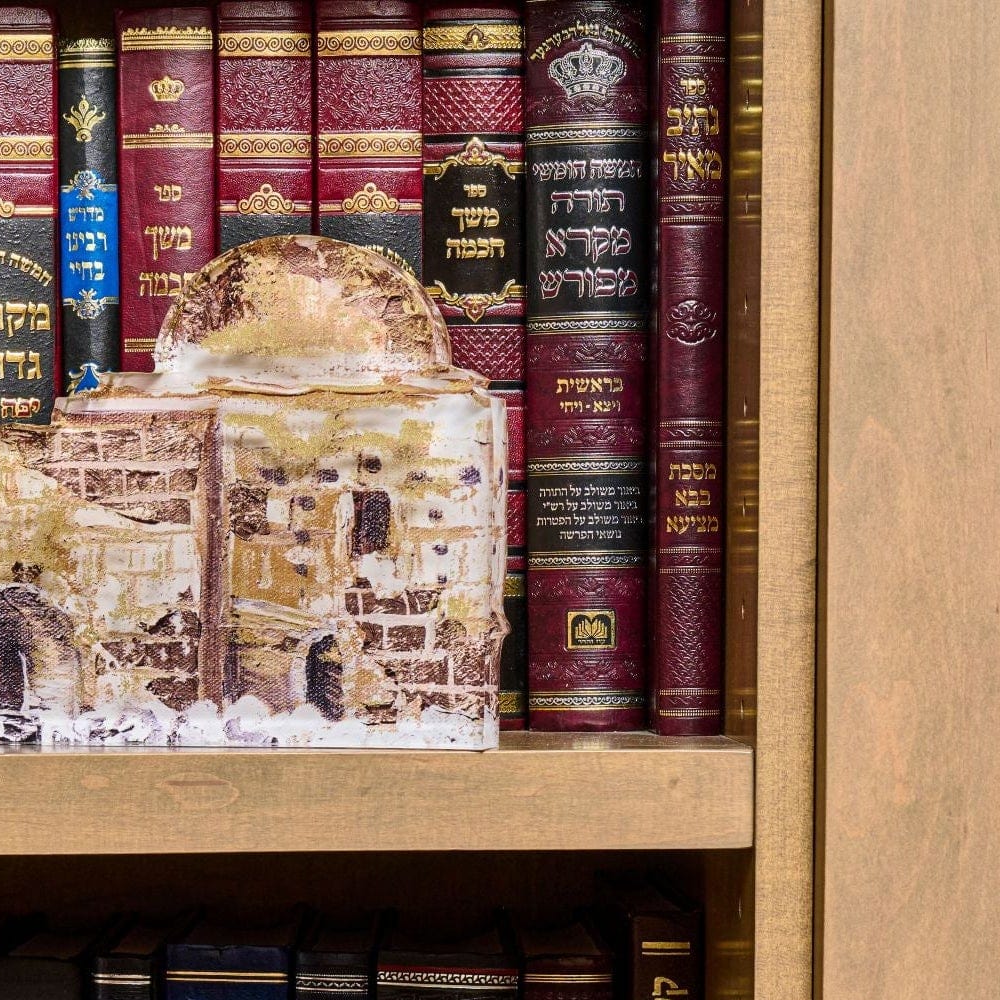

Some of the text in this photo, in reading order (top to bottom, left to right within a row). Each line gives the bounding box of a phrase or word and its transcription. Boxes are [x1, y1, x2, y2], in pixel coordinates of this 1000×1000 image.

[680, 78, 706, 95] ספר
[666, 104, 718, 136] נתיב
[532, 158, 642, 181] חמשה חומשי
[663, 149, 722, 181] מאיר
[154, 185, 182, 201] ספר
[463, 183, 487, 198] ספר
[551, 188, 625, 214] תורה
[68, 206, 104, 222] מדרש
[451, 206, 500, 232] משך
[66, 232, 107, 252] רבינו
[144, 225, 192, 260] משך
[446, 237, 505, 260] חכמה
[545, 225, 631, 264] מקרא
[9, 252, 52, 287] חמשה
[69, 261, 105, 281] בחיי
[539, 266, 638, 300] מפורש
[555, 376, 624, 394] בראשית
[1, 398, 40, 418] יפה
[559, 400, 621, 413] ויצא ויחי
[668, 462, 716, 480] מסכת
[540, 487, 567, 497] התורה
[569, 484, 582, 497] על
[584, 484, 616, 496] משולב
[675, 489, 710, 507] בבא
[560, 530, 622, 539] נושאי הפרשה
[666, 516, 718, 535] מציעא
